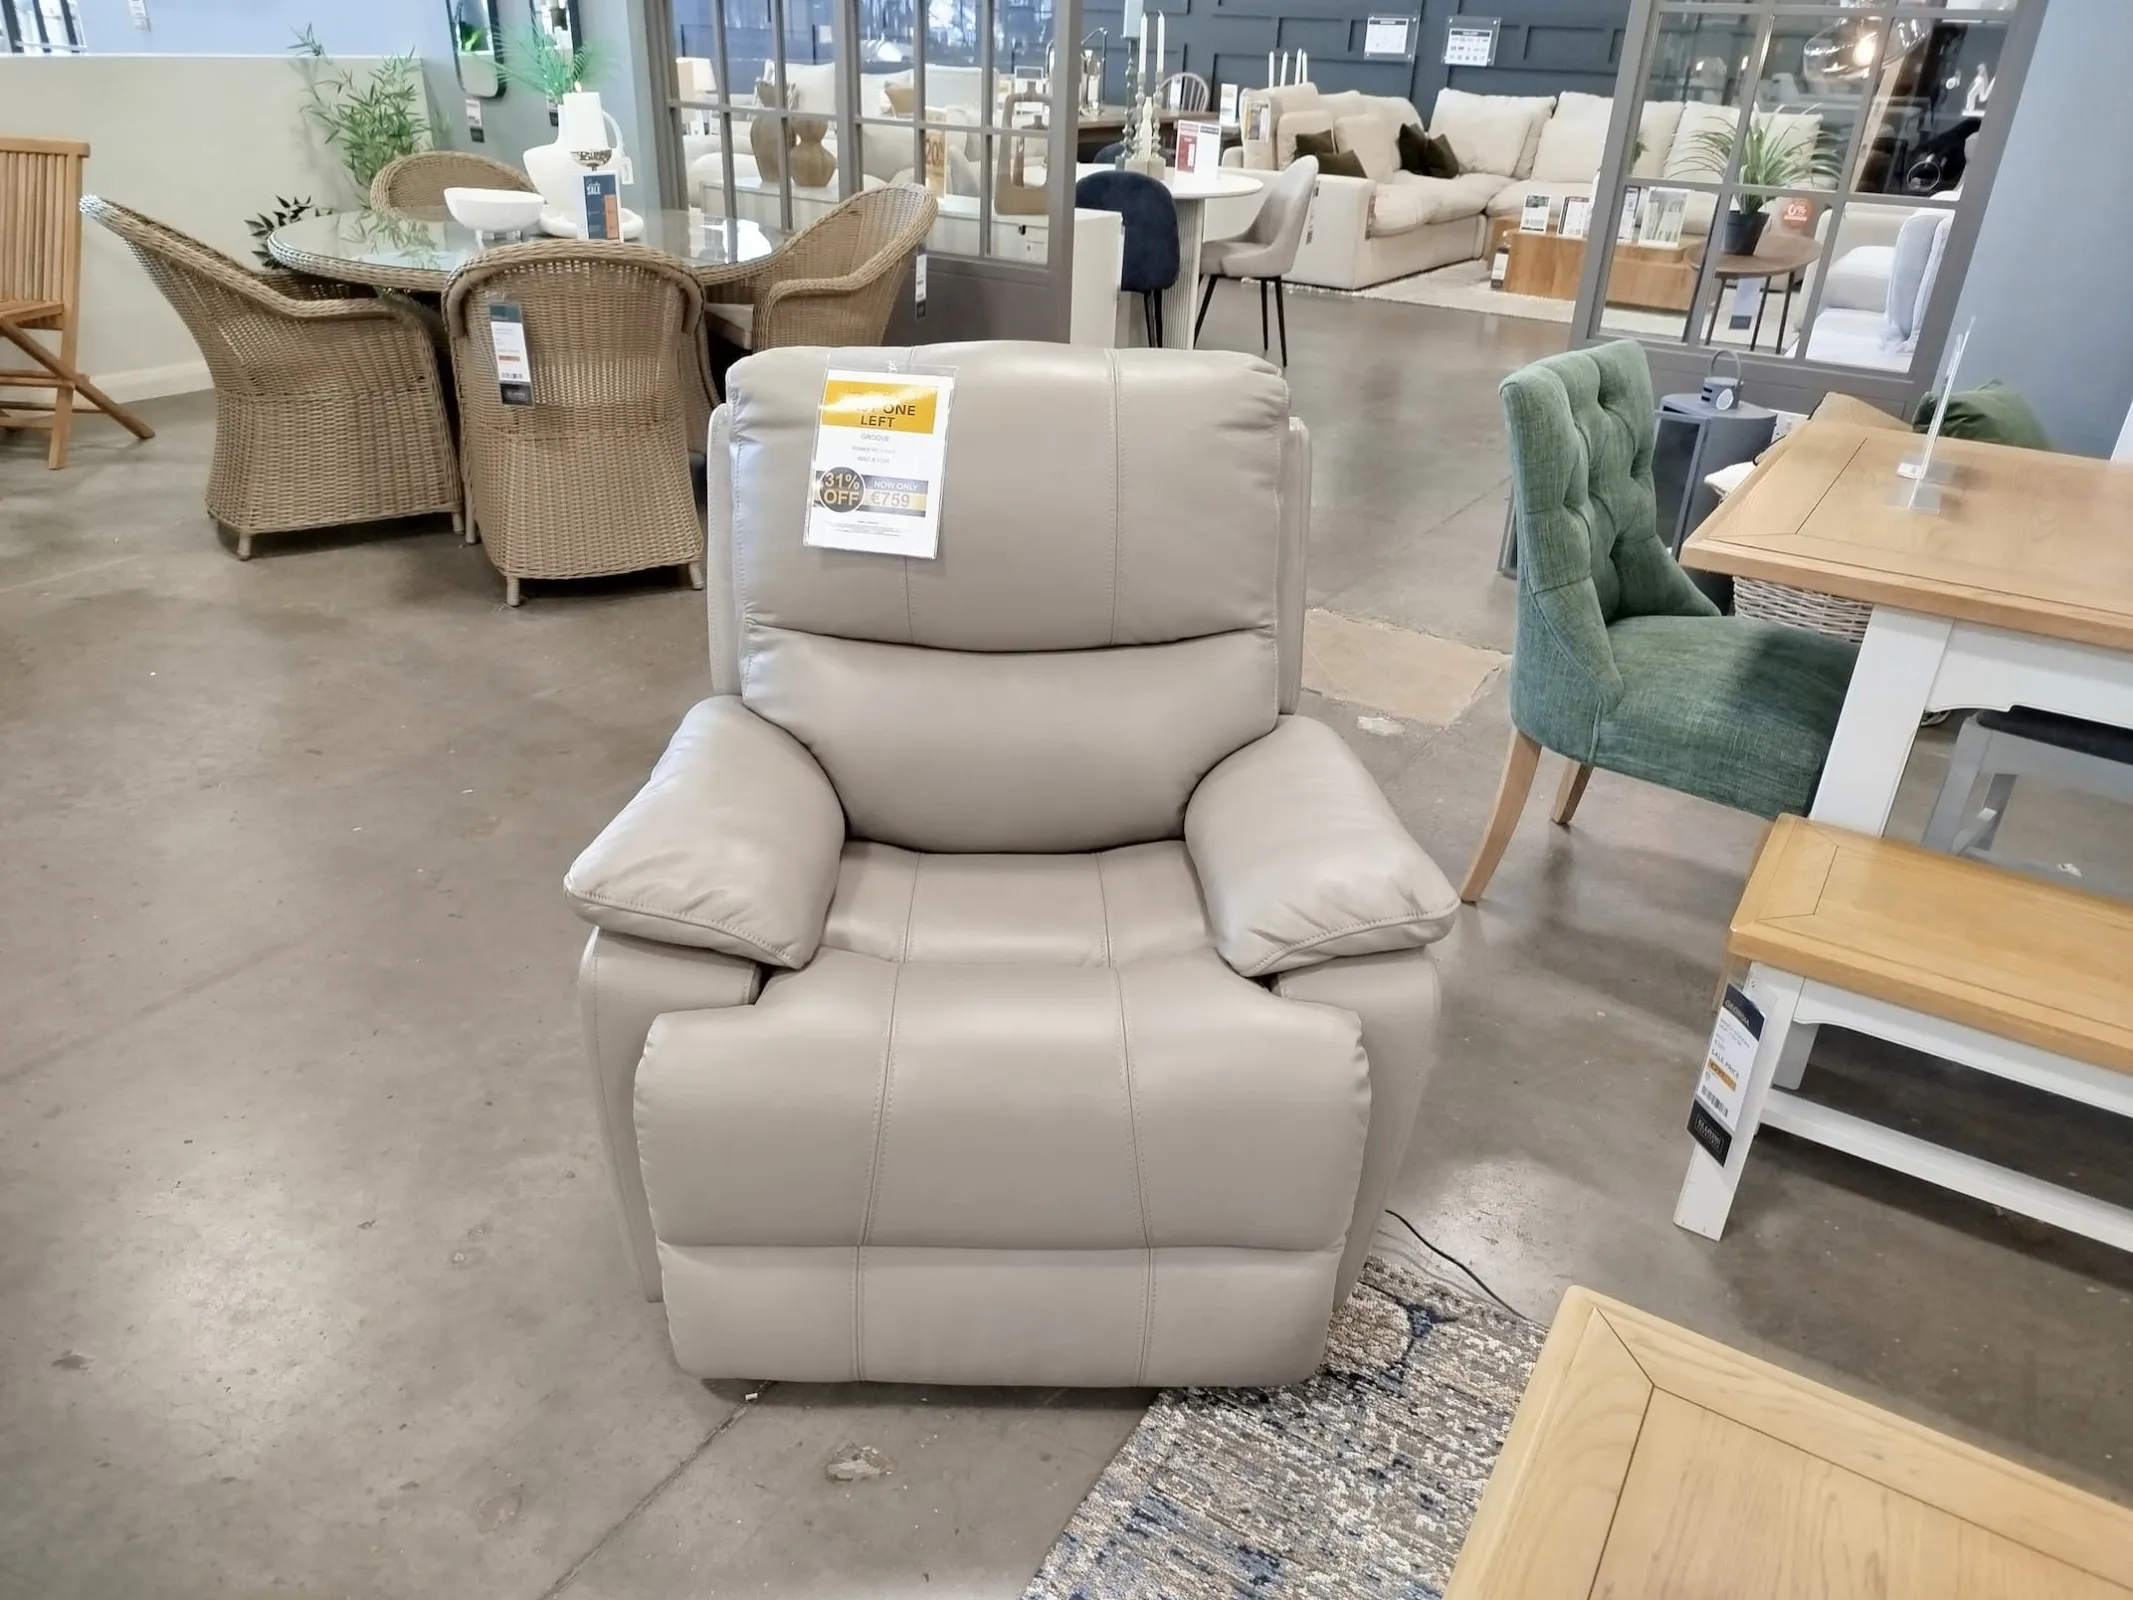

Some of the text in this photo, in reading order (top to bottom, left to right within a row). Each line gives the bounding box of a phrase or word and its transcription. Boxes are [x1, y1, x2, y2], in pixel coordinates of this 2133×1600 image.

[883, 404, 916, 416] ONE
[860, 415, 896, 428] LEFT
[825, 472, 860, 490] 31%
[874, 480, 918, 491] NOW ONLY
[823, 489, 860, 506] OFF
[871, 490, 910, 508] €759
